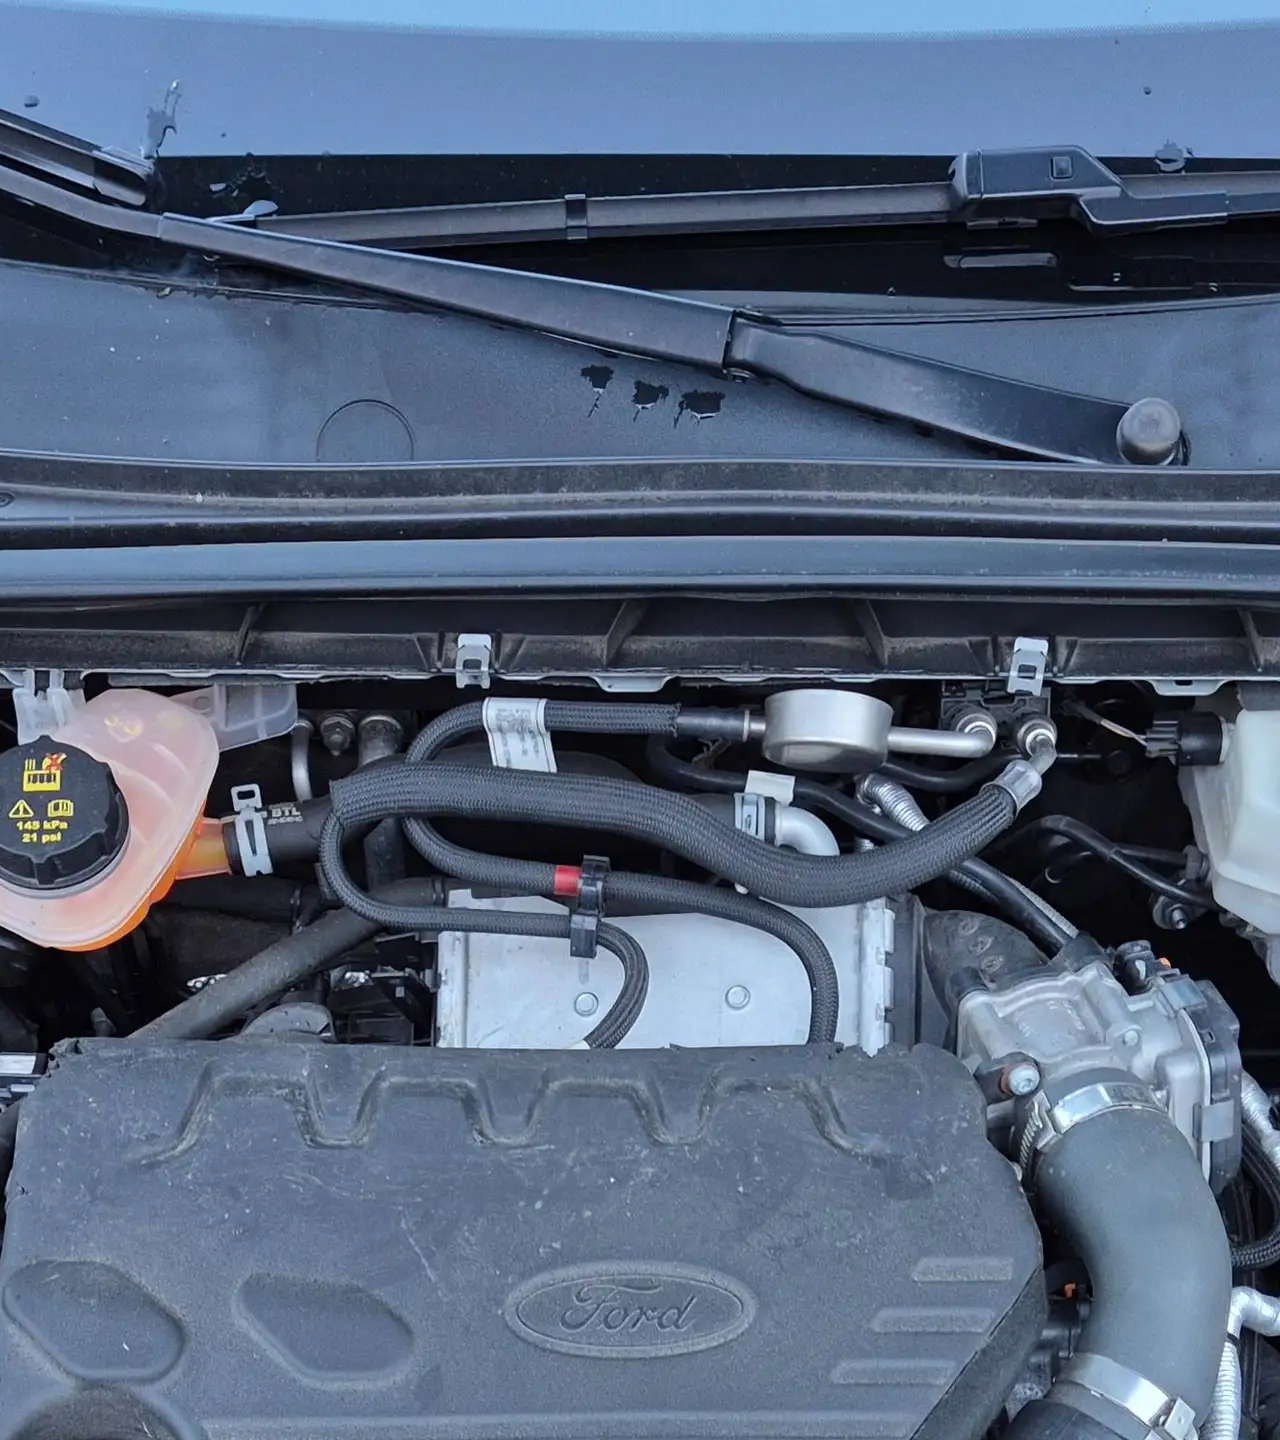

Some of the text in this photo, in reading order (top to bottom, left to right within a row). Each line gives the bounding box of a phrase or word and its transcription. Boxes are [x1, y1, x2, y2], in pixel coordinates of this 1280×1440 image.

[16, 820, 68, 831] 145 kPa
[22, 831, 62, 844] 21 psi
[559, 1283, 697, 1333] Ford
